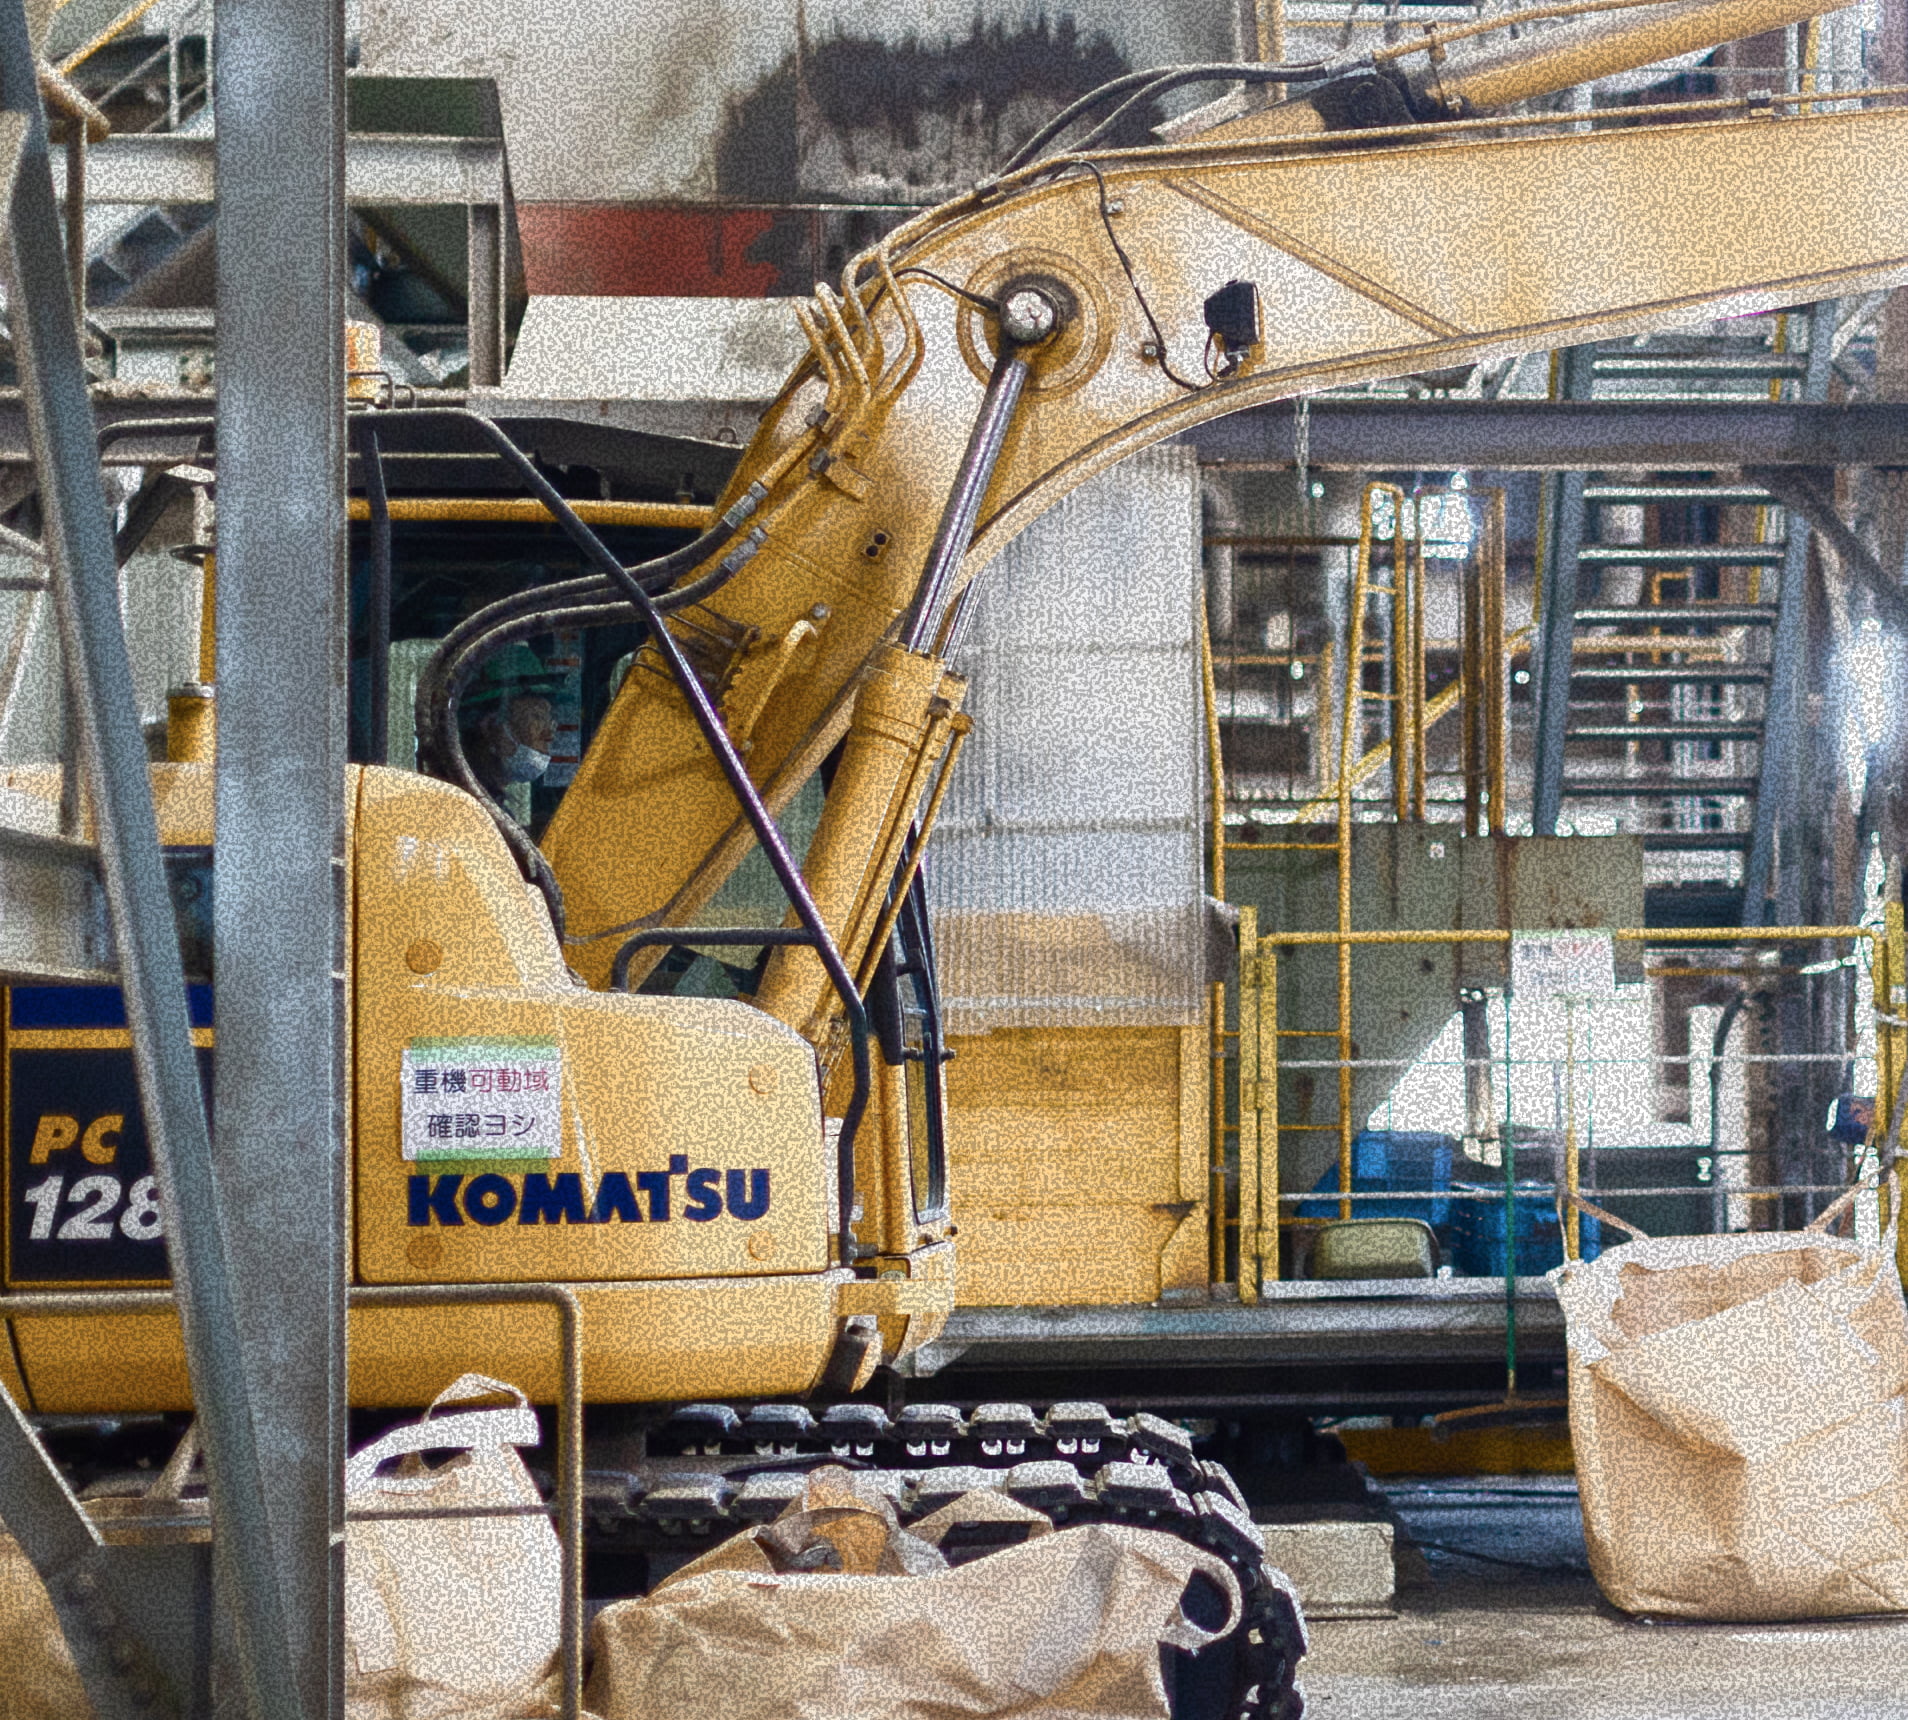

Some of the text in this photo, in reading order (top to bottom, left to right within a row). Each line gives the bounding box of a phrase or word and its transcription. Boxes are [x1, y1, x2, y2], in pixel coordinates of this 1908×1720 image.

[414, 1068, 550, 1094] 重機可動域
[29, 1114, 125, 1165] PC
[427, 1113, 535, 1139] 確認ヨシ
[24, 1174, 164, 1240] 128
[407, 1154, 770, 1227] KOMATSU
